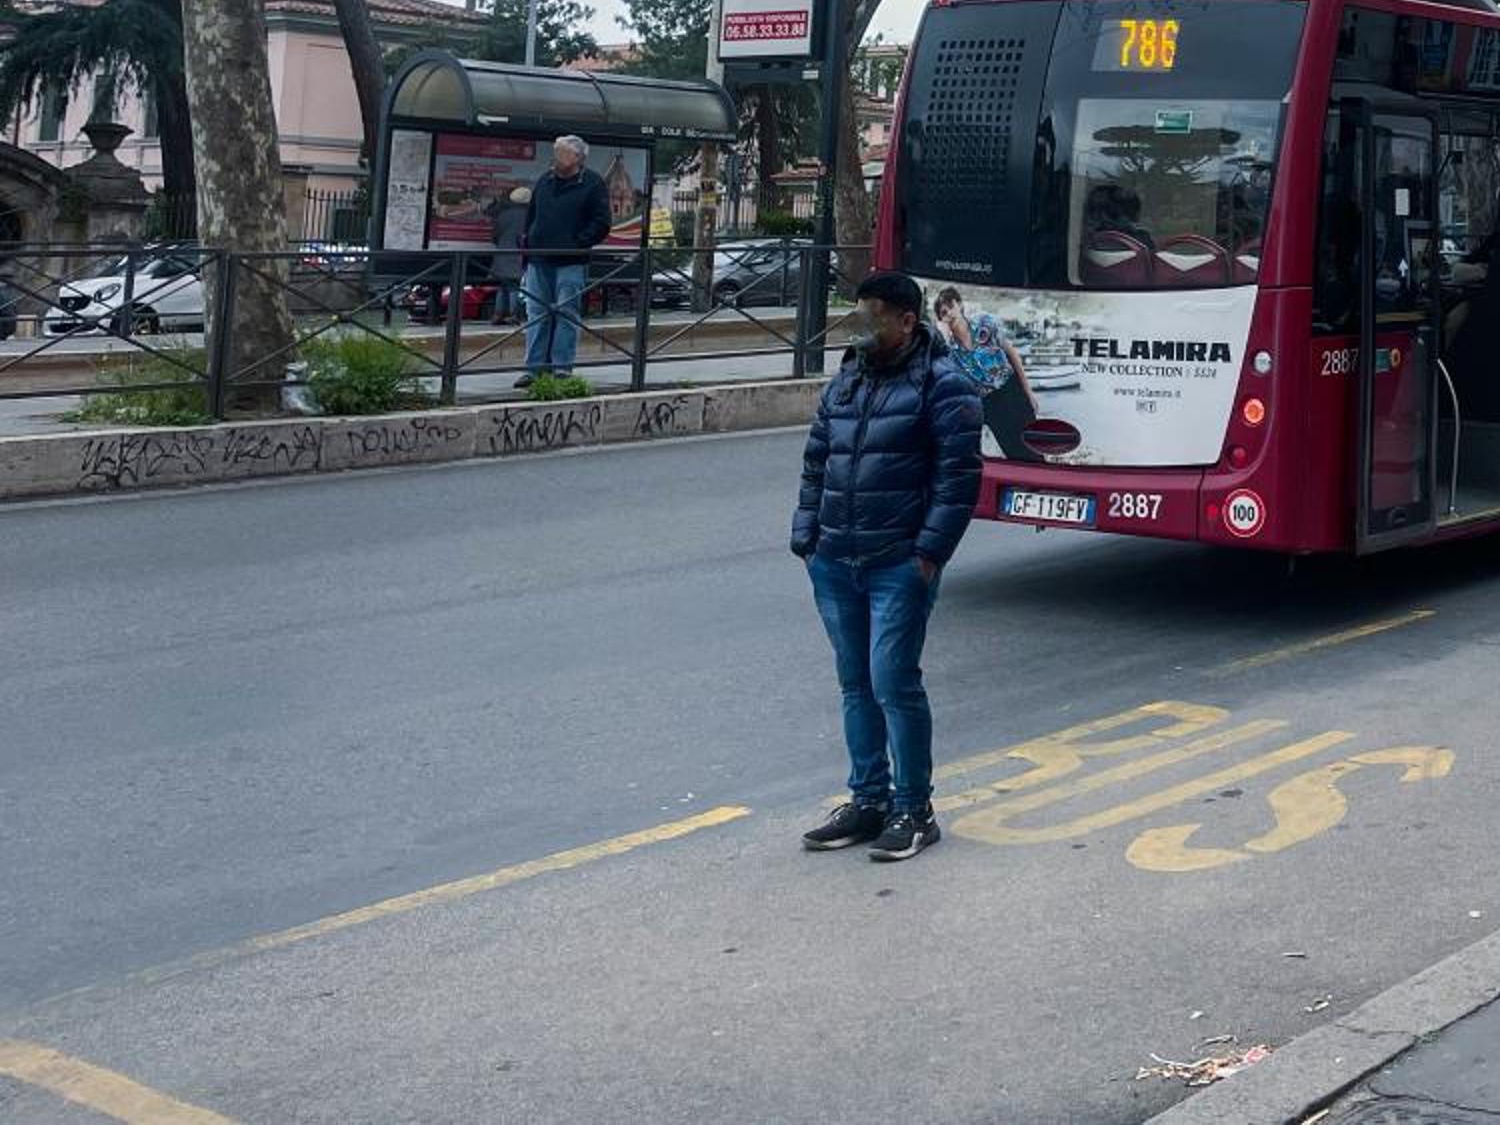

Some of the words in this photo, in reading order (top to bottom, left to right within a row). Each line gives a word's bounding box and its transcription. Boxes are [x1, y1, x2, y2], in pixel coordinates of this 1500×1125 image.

[1120, 20, 1179, 68] 786
[1070, 338, 1231, 362] TELAMIRA
[1082, 363, 1106, 374] NEW
[1109, 364, 1183, 378] COLLECTION
[1109, 492, 1163, 519] 2887
[1233, 504, 1256, 522] 100
[828, 700, 1456, 872] BUS
